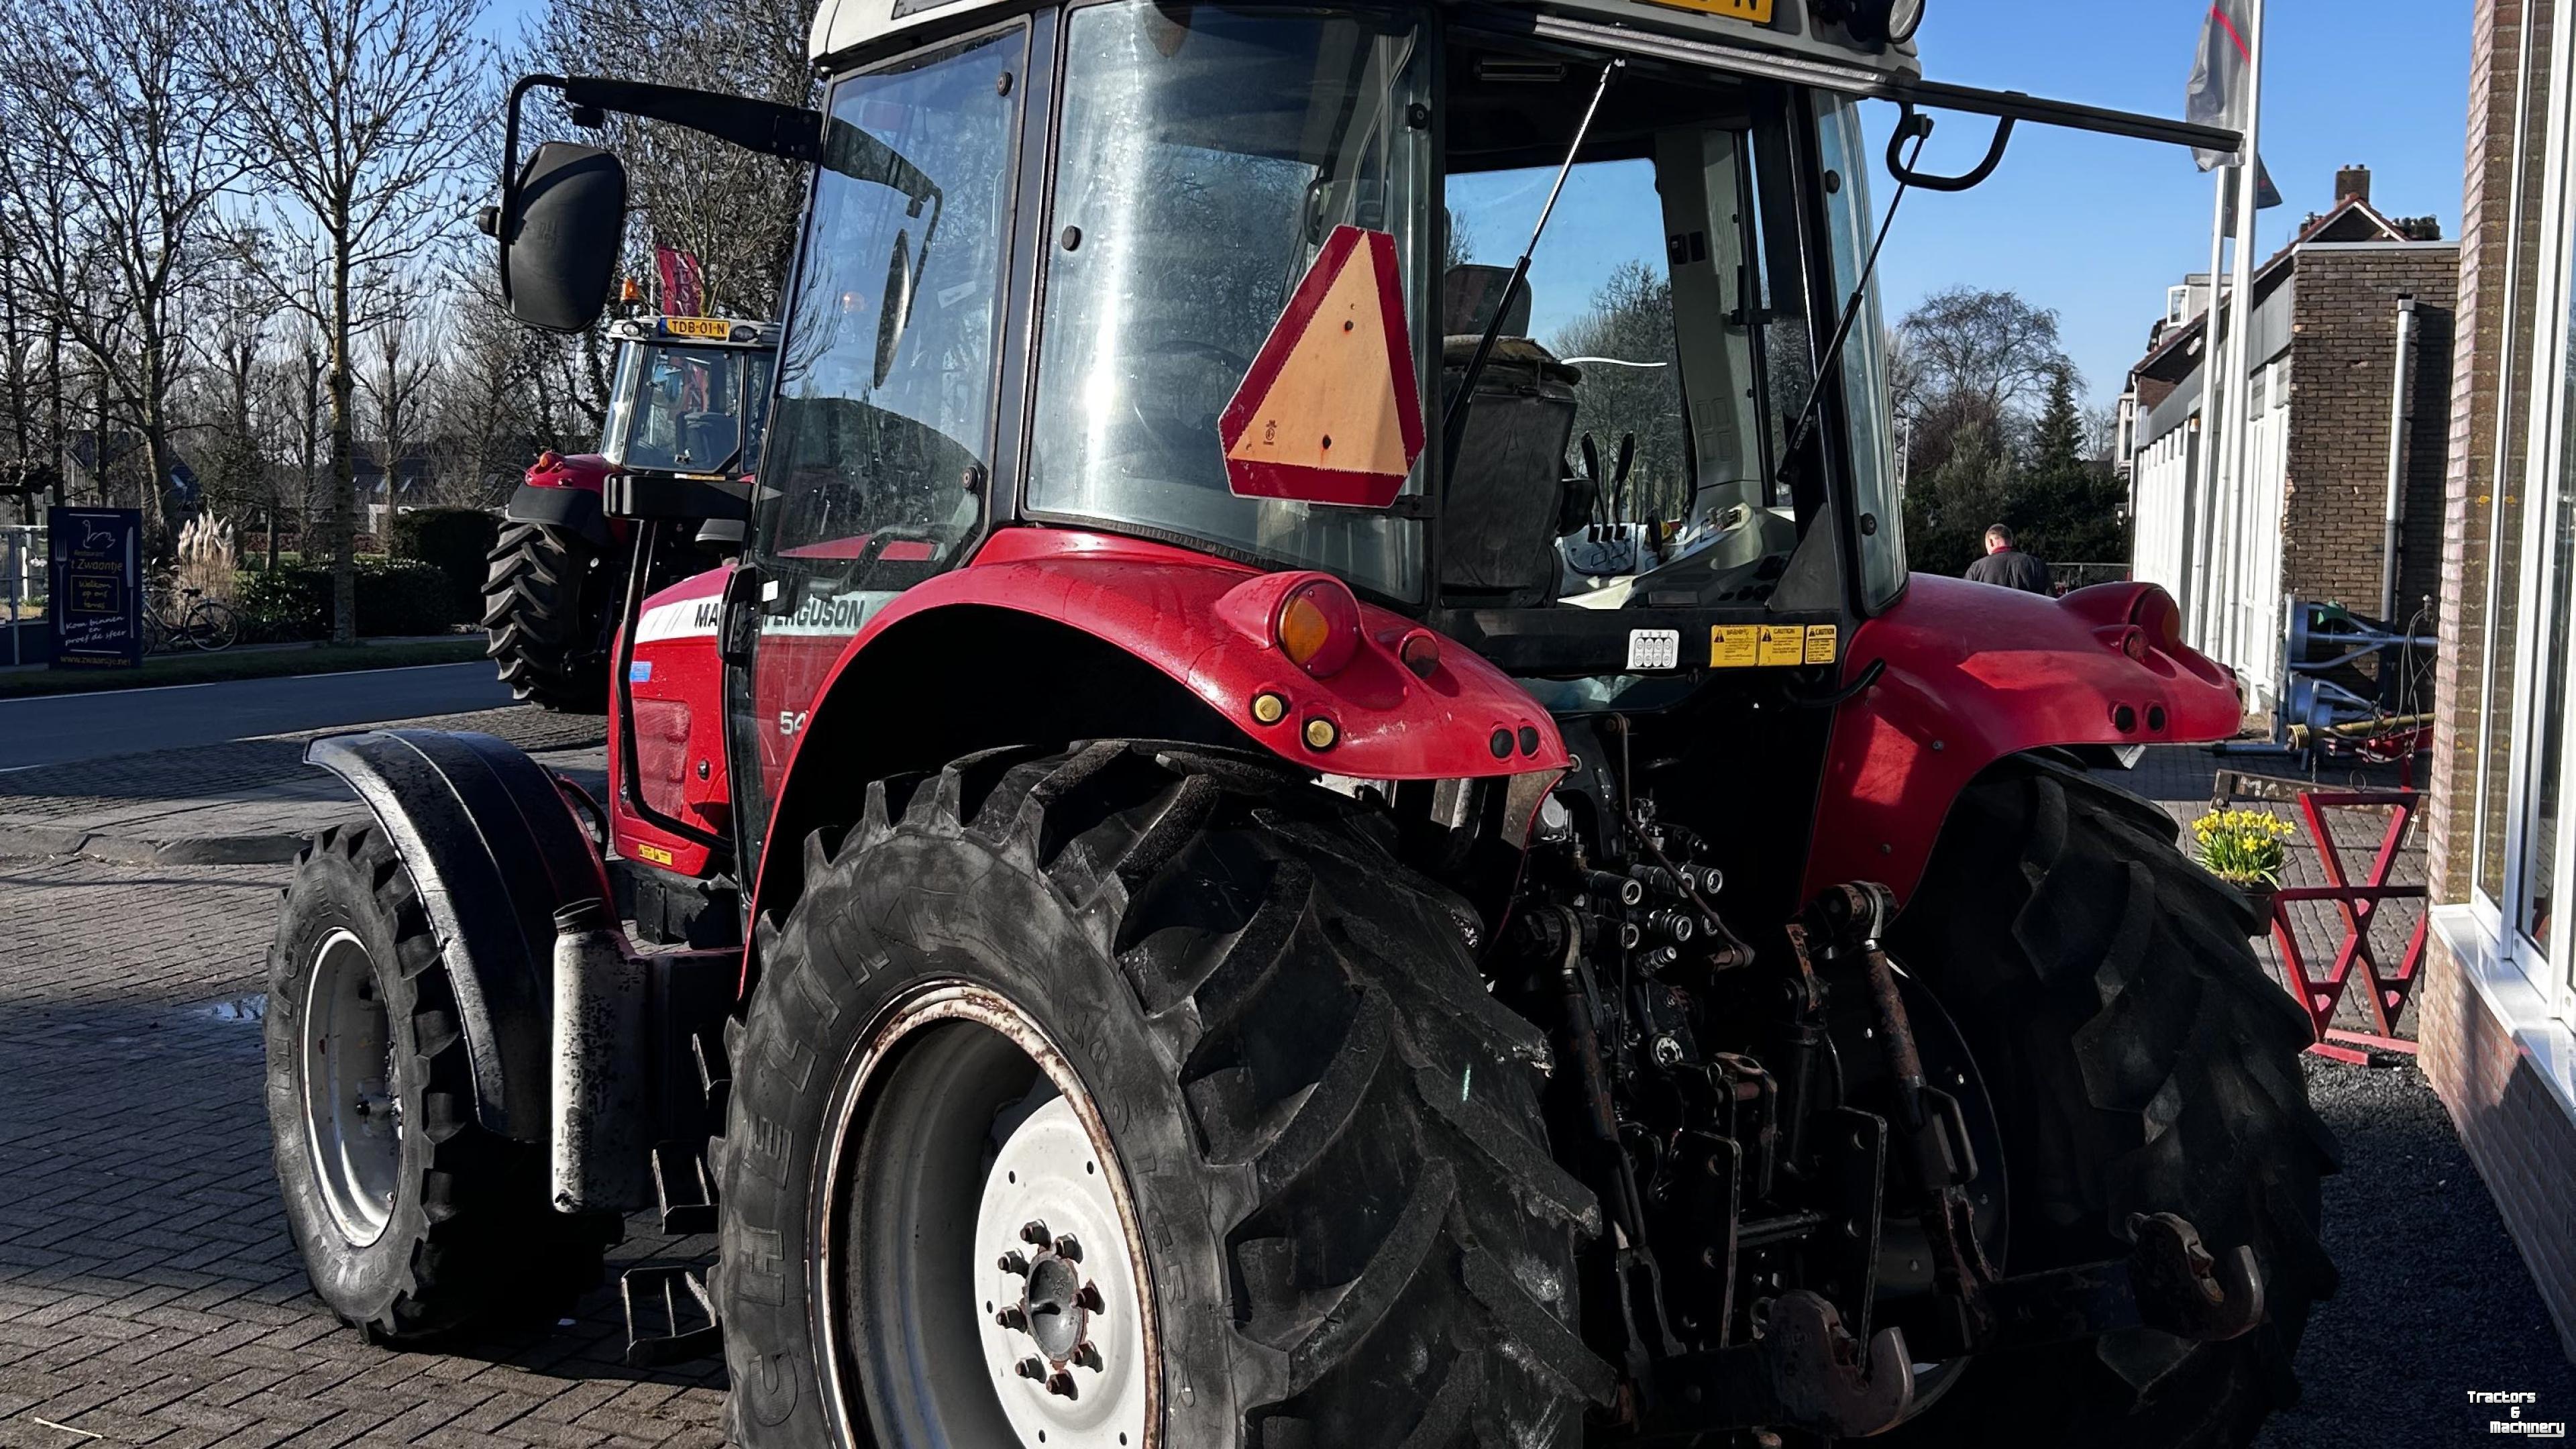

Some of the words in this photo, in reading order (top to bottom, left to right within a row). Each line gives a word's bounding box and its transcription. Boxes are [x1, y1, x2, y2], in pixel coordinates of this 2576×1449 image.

[672, 321, 724, 335] TDB-01-N
[76, 559, 123, 574] Zwaantje
[65, 621, 88, 630] Kom
[89, 616, 125, 627] binnen
[65, 633, 90, 647] proef
[91, 632, 103, 641] de
[105, 629, 127, 641] sfeer
[780, 710, 808, 735] 54
